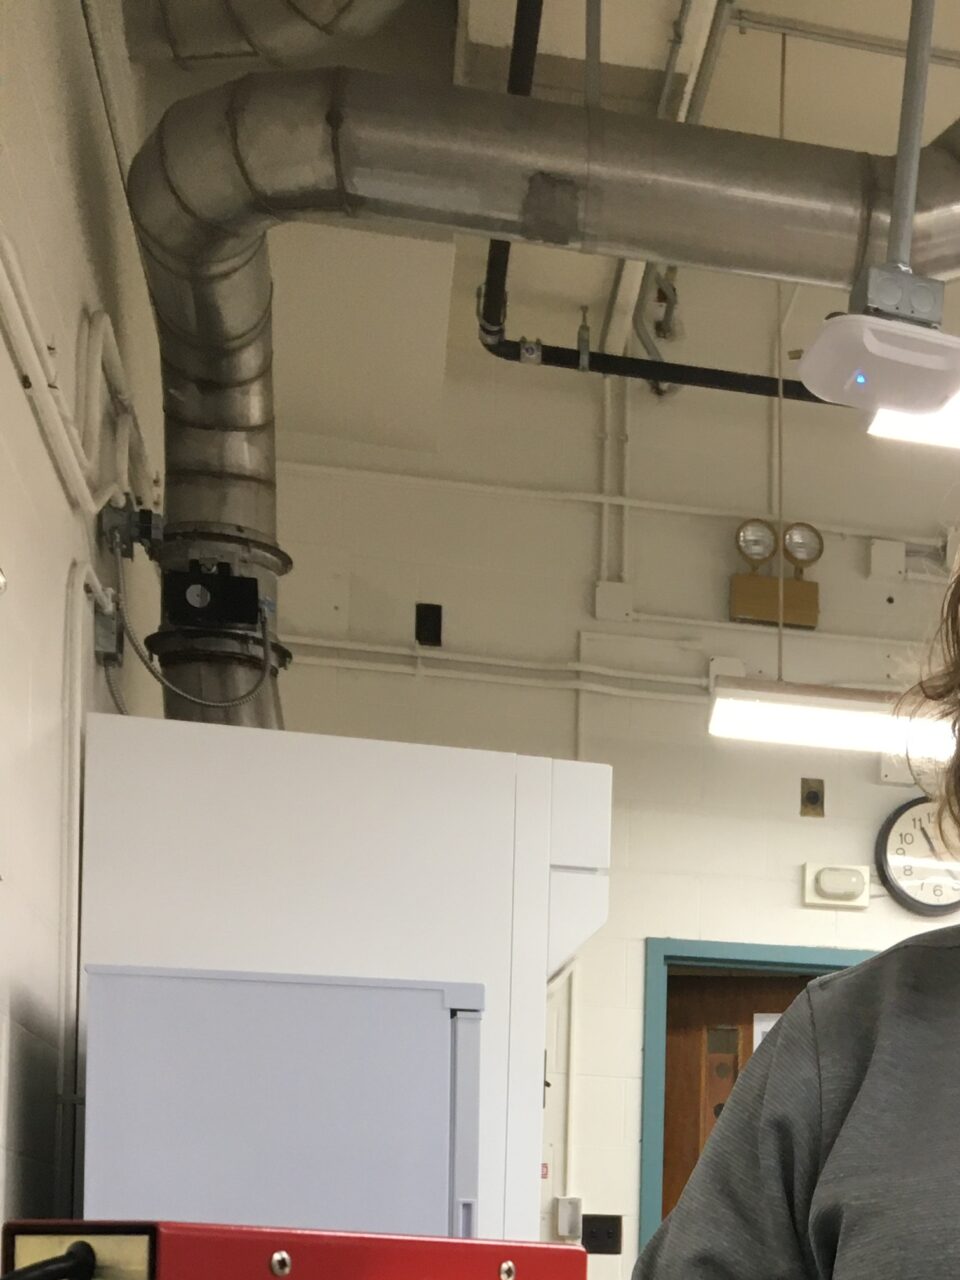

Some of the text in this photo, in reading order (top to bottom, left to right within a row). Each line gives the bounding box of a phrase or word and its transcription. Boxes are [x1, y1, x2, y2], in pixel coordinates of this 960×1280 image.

[912, 817, 923, 829] 11
[899, 832, 914, 845] 10
[903, 864, 913, 877] 8
[933, 884, 943, 897] 6
